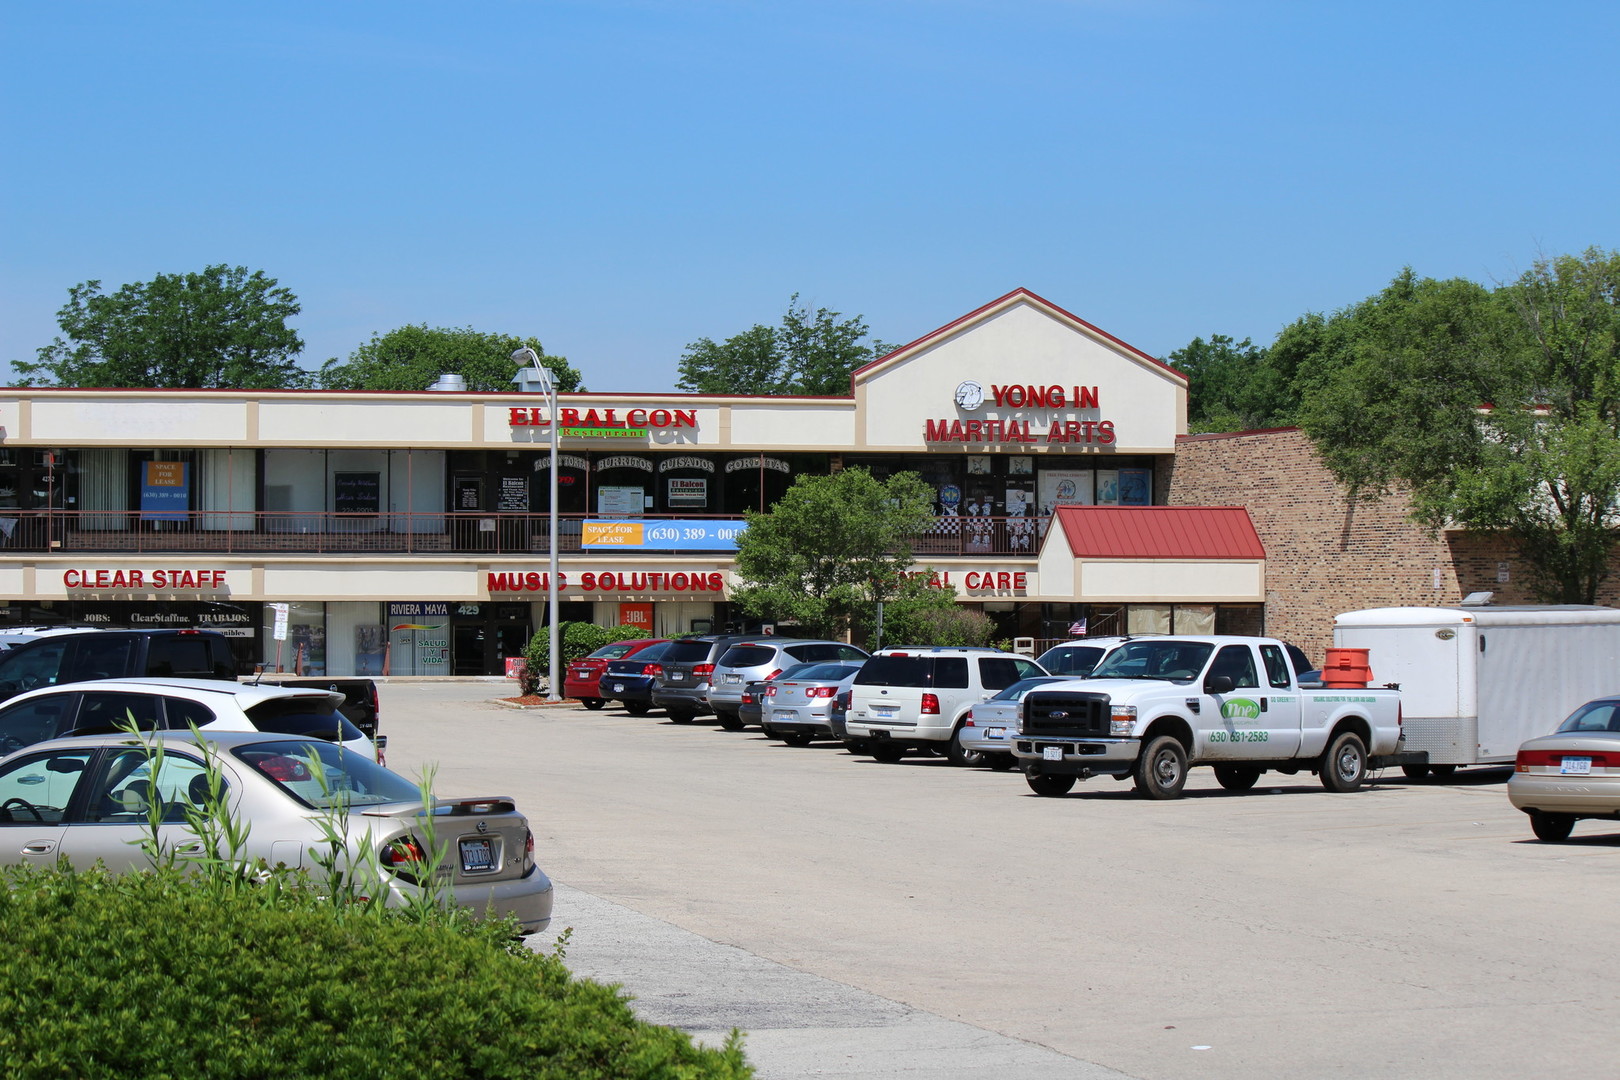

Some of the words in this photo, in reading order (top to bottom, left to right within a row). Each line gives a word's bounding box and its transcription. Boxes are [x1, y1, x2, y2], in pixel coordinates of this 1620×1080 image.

[991, 384, 1066, 408] YONG
[1073, 385, 1099, 409] IN
[508, 407, 552, 426] EL
[559, 408, 697, 428] BALCON
[562, 428, 644, 437] Restaurant
[925, 419, 1038, 443] MARTIAL
[1046, 420, 1116, 445] ARTS
[534, 456, 556, 472] TACO
[597, 456, 653, 472] BURRITOS
[659, 457, 715, 473] GUISADOS
[725, 457, 790, 473] GORDITAS
[557, 476, 575, 484] PEN
[672, 480, 678, 488] El
[680, 480, 704, 488] Balcon
[587, 526, 615, 534] SPACE
[615, 526, 633, 534] FOR
[647, 528, 680, 543] (630)
[683, 528, 706, 540] 389
[597, 536, 625, 544] LEASE
[63, 569, 143, 588] CLEAR
[152, 569, 226, 589] STAFF
[487, 572, 567, 591] MUSIC
[580, 572, 724, 591] SOLUTIONS
[965, 571, 1027, 590] CARE
[391, 603, 421, 615] RIVIERA
[425, 603, 448, 615] MAYA
[458, 605, 480, 615] 429
[84, 613, 111, 622] JOBS:
[198, 613, 250, 622] TRABAJOS:
[626, 610, 647, 623] JBL
[1208, 731, 1229, 743] (630)
[1230, 731, 1269, 743] 631-2583
